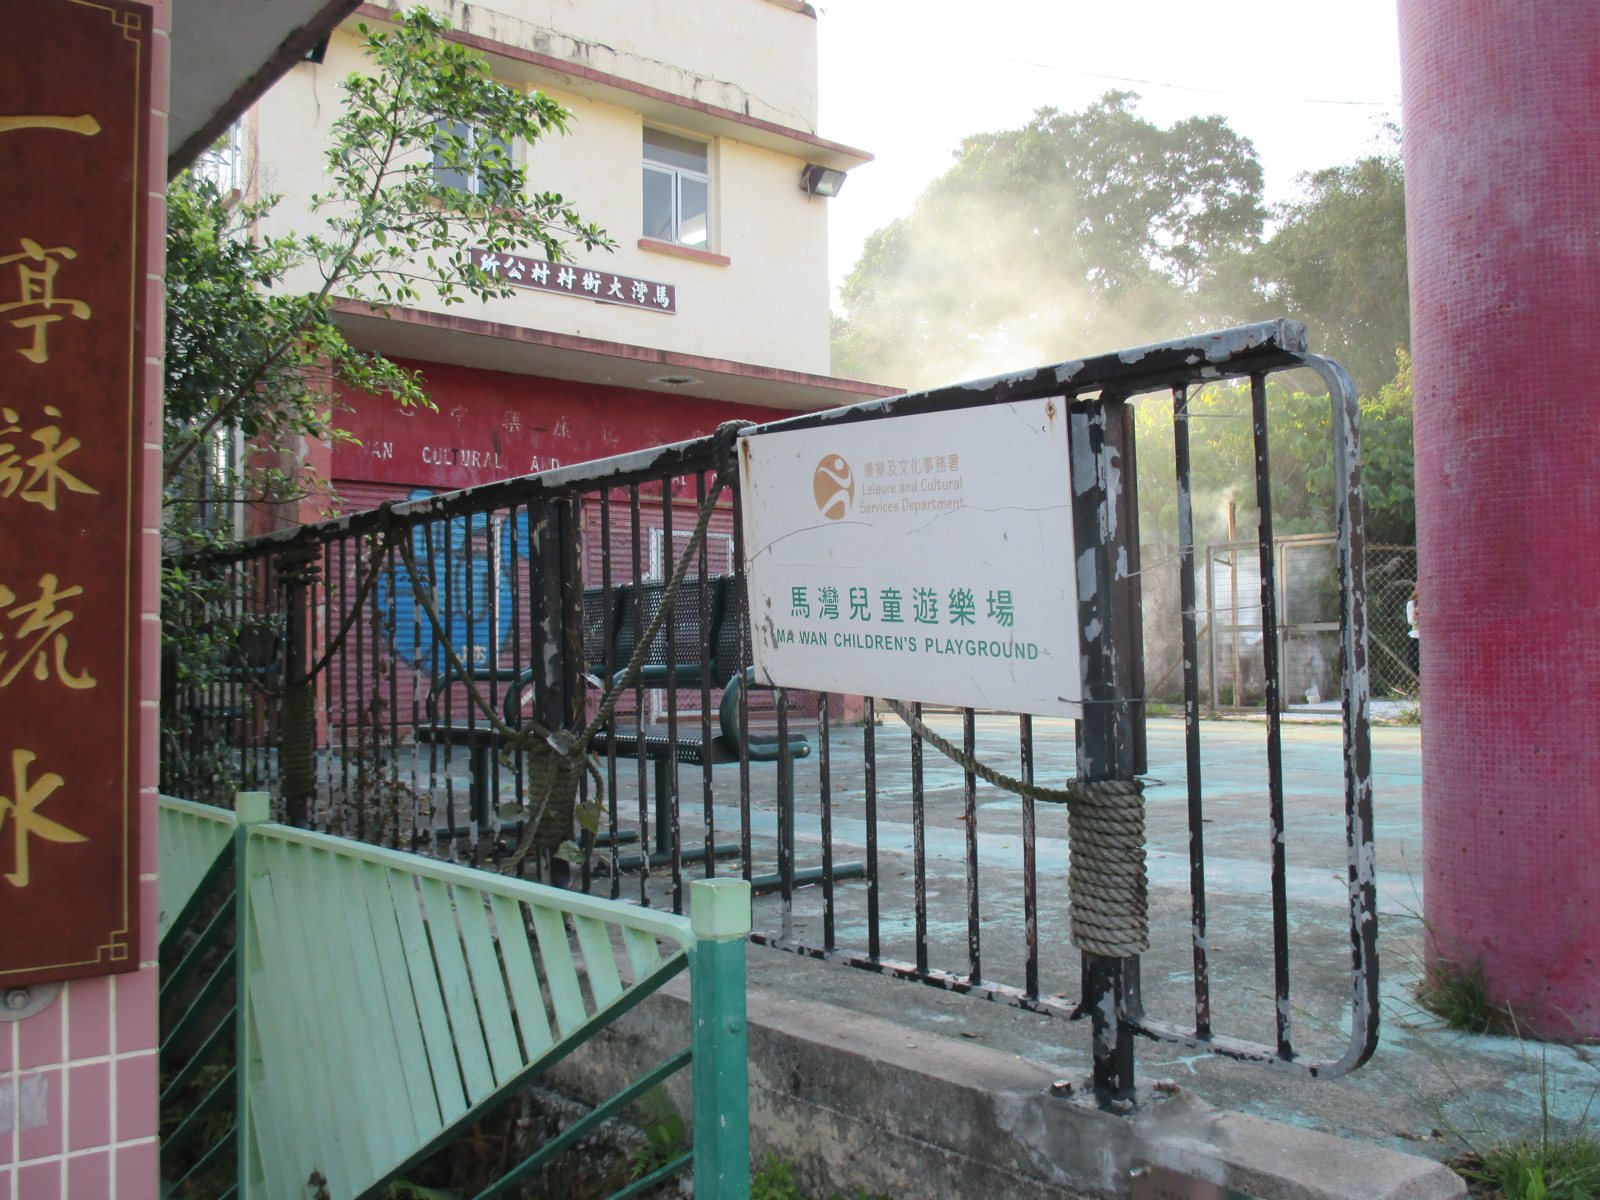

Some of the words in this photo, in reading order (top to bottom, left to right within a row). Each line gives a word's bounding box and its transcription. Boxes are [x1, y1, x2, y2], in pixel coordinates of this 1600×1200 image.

[422, 446, 503, 469] CULTURAL
[863, 454, 960, 479] 康樂及文化事務署
[862, 483, 897, 496] Leisure
[899, 479, 918, 494] and
[921, 476, 963, 492] Cultural
[859, 501, 899, 514] Services
[902, 498, 964, 516] Department
[791, 586, 1014, 627] 馬灣兒童遊樂場
[776, 629, 795, 643] MA
[799, 630, 828, 646] WAN
[833, 632, 917, 652] CHILDREN'S
[925, 637, 1038, 660] PLAYGROUND
